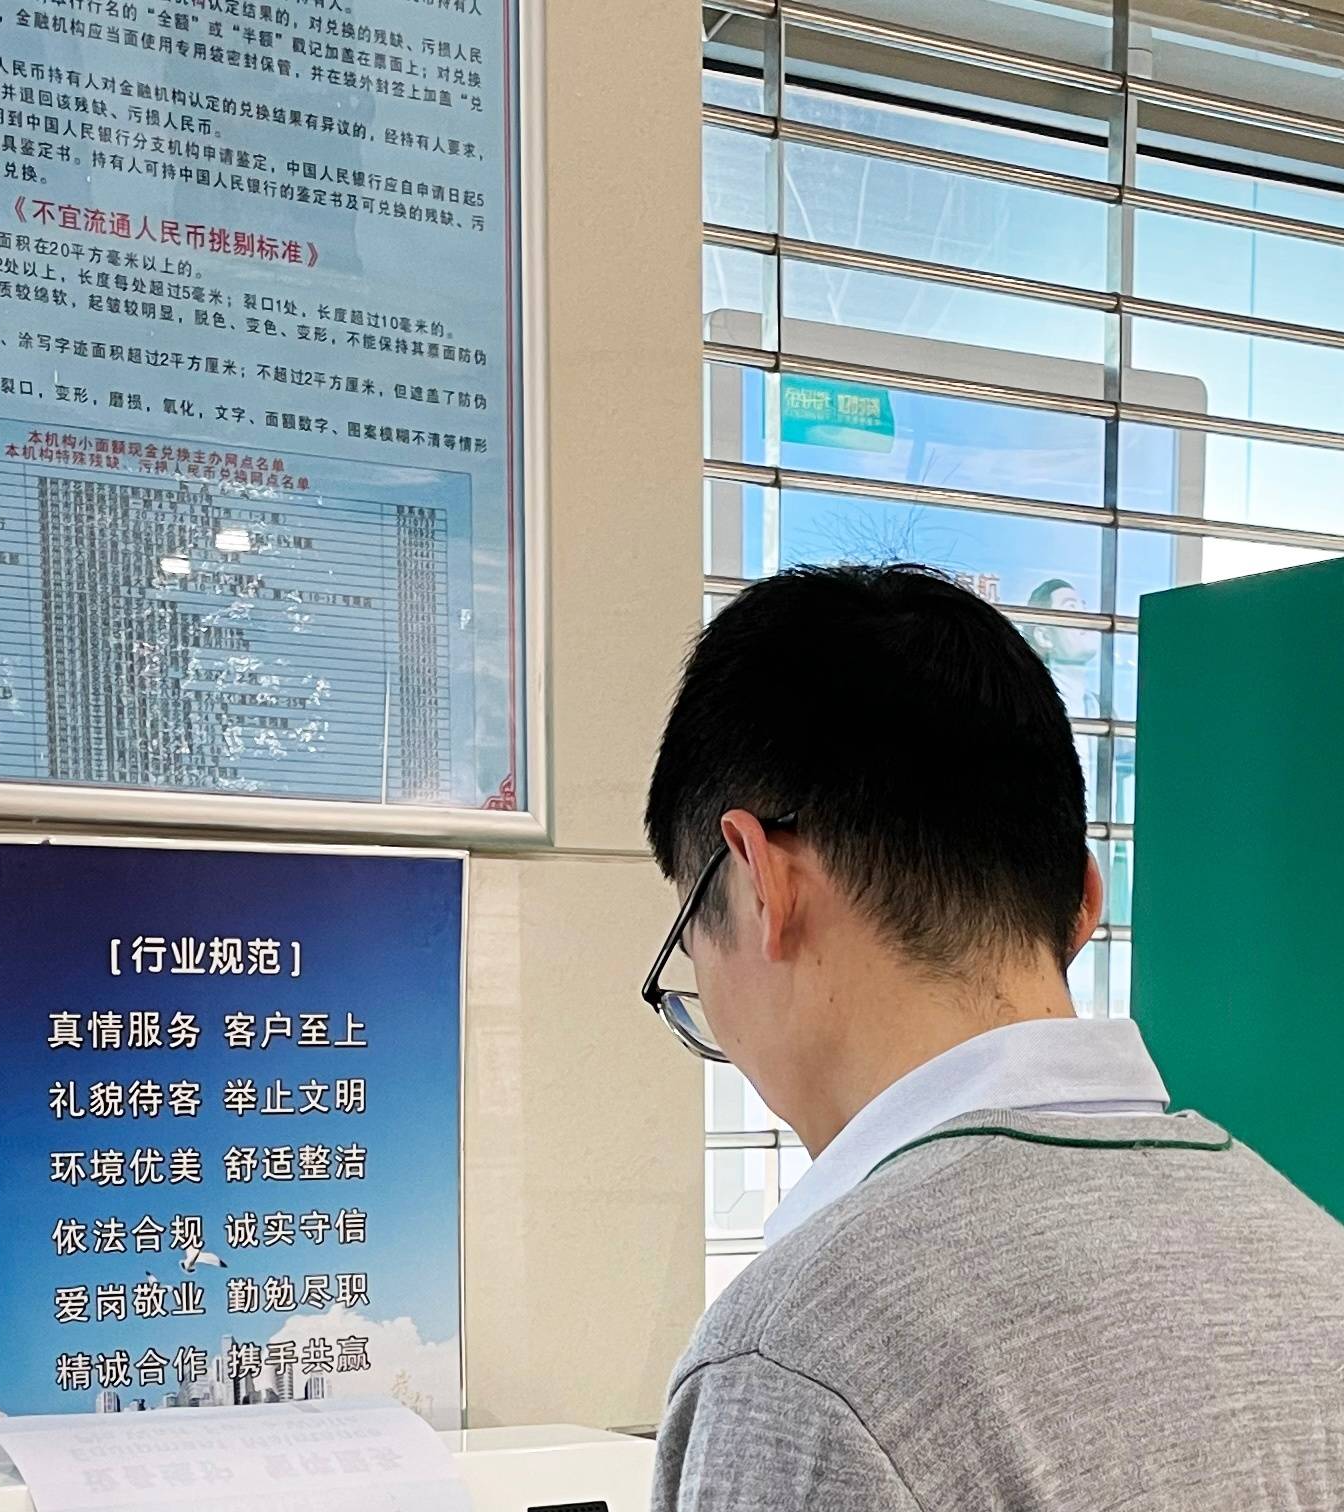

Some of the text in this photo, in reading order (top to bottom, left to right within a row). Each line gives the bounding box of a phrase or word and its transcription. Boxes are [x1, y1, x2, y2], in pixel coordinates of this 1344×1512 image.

[12, 195, 321, 268] 《不宜流通人民币挑剔标准》
[47, 1011, 368, 1049] 真情服务 客户至上
[48, 1079, 366, 1118] 礼貌待客 举止文明
[49, 1144, 366, 1185] 环境优美 舒适整洁
[52, 1209, 367, 1255] 依法合规 诚实守信
[54, 1273, 370, 1323] 爱岗敬业 勤勉尽职
[56, 1336, 371, 1390] 精诚合作 携手共赢
